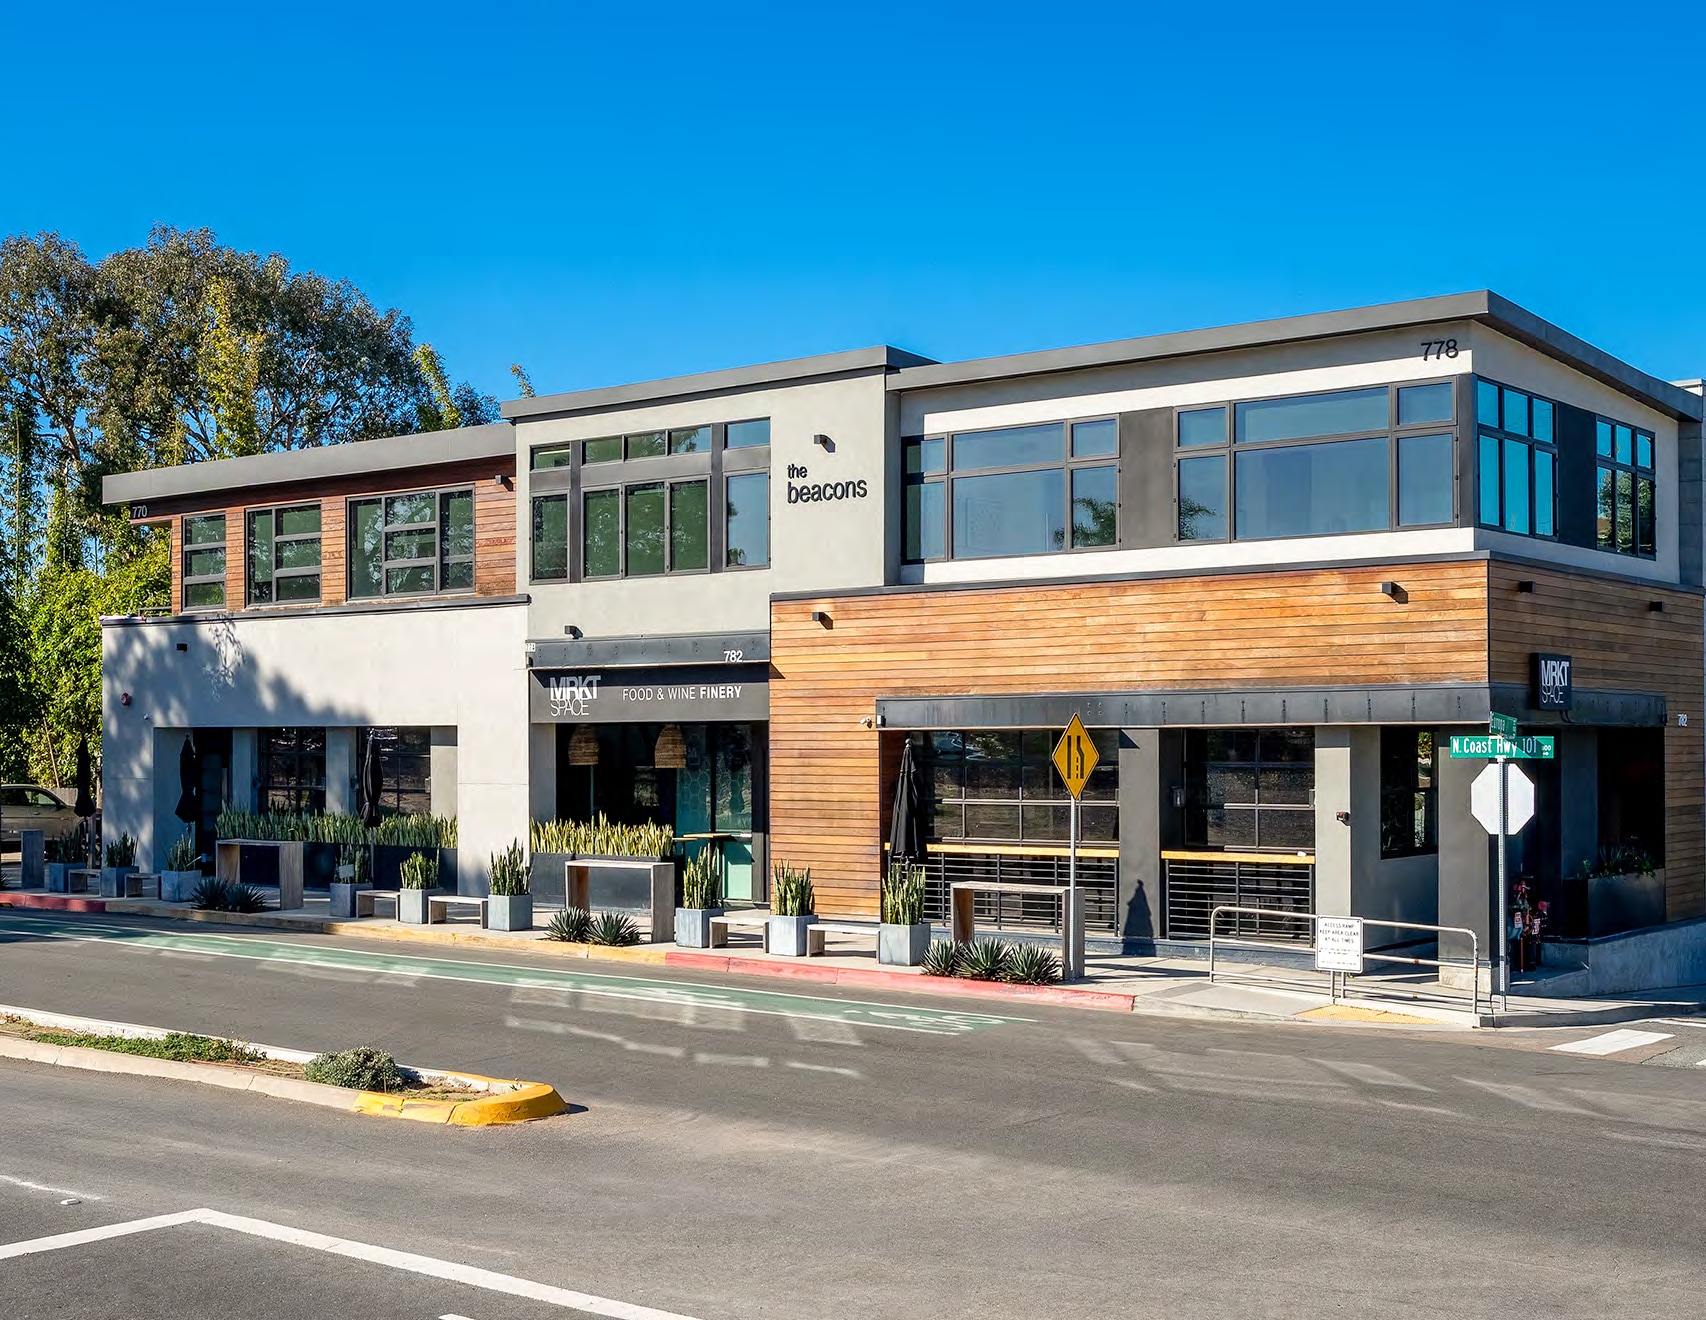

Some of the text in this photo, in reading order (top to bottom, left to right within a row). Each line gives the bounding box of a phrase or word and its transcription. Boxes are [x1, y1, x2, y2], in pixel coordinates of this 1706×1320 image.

[1420, 338, 1459, 361] 778
[787, 463, 808, 479] the
[787, 479, 868, 504] beacons
[132, 504, 148, 518] 770
[723, 650, 743, 662] 782
[1541, 660, 1570, 686] MRKT
[550, 675, 601, 700] MRKT
[622, 685, 742, 701] FOOD & WINE FINERY
[1541, 684, 1564, 704] SPACE
[550, 698, 589, 716] SPACE
[1452, 738, 1537, 757] N. Coast Hwy 101
